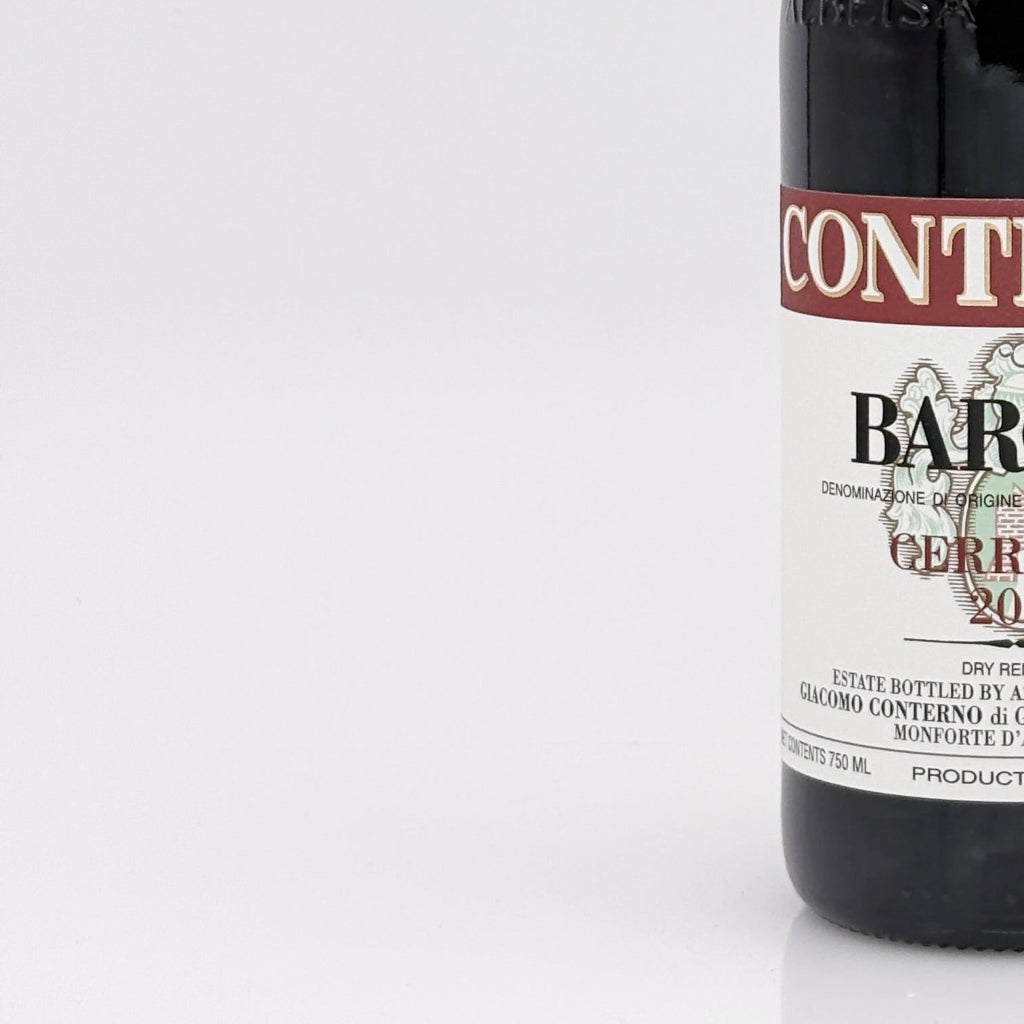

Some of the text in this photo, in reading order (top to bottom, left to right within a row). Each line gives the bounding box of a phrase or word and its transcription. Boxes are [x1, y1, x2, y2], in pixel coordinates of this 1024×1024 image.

[822, 480, 925, 505] DENOMINAZIONE
[933, 492, 948, 506] DI
[955, 493, 1022, 508] ORIGINE
[962, 661, 994, 676] DRY
[832, 668, 886, 694] ESTATE
[890, 677, 973, 700] BOTTLED
[978, 683, 1005, 701] BY
[800, 681, 863, 714] GIACOMO
[869, 696, 982, 725] CONTERNO
[990, 706, 1008, 725] di
[894, 724, 995, 747] MONFORTE
[788, 735, 826, 765] CONTENTS
[828, 750, 849, 771] 750
[852, 755, 872, 775] ML
[912, 767, 1024, 785] PRODUCT
